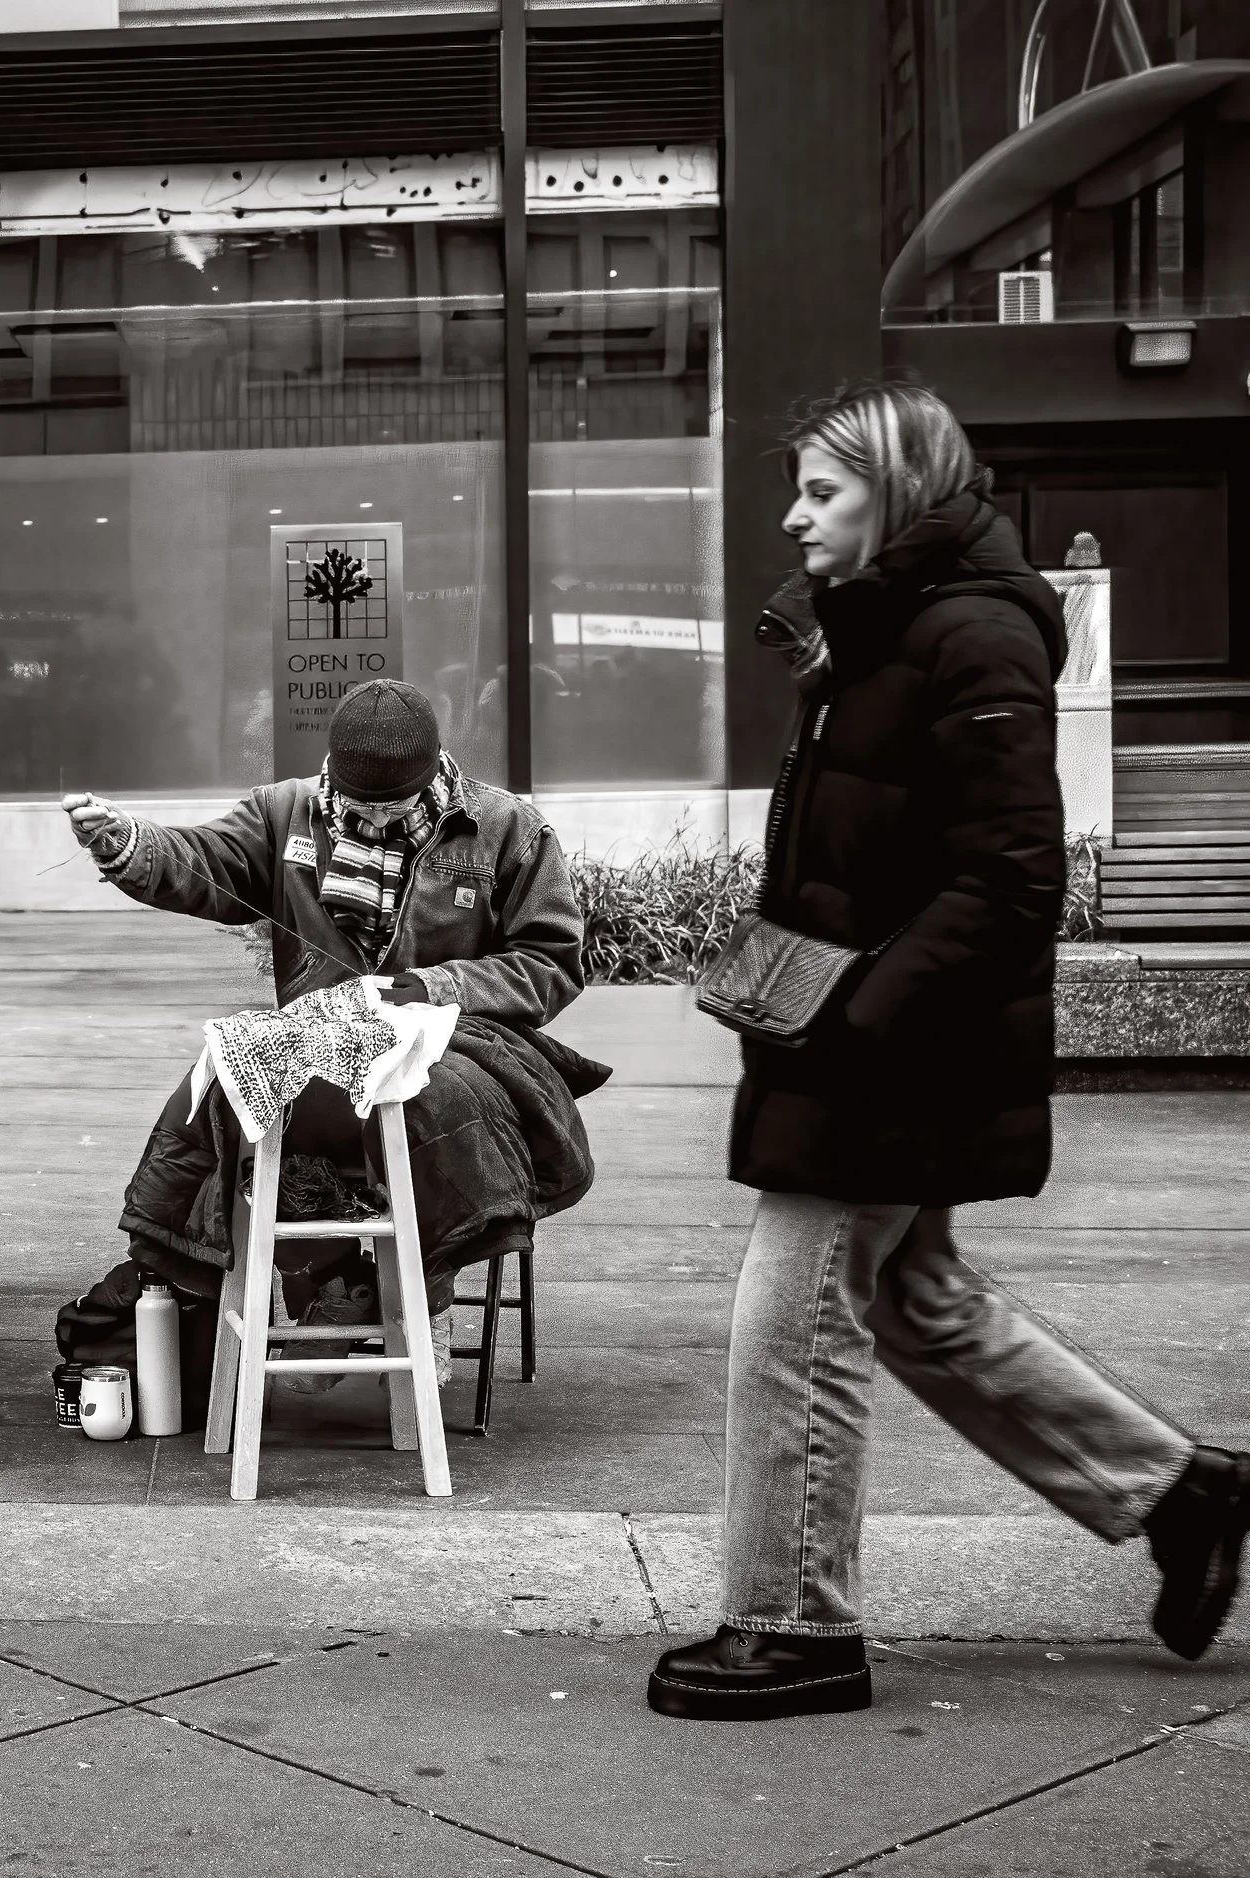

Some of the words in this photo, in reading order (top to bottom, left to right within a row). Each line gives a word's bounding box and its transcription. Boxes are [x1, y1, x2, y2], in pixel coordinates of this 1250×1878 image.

[288, 654, 347, 672] OPEN
[356, 653, 385, 672] TO
[55, 1388, 65, 1401] E
